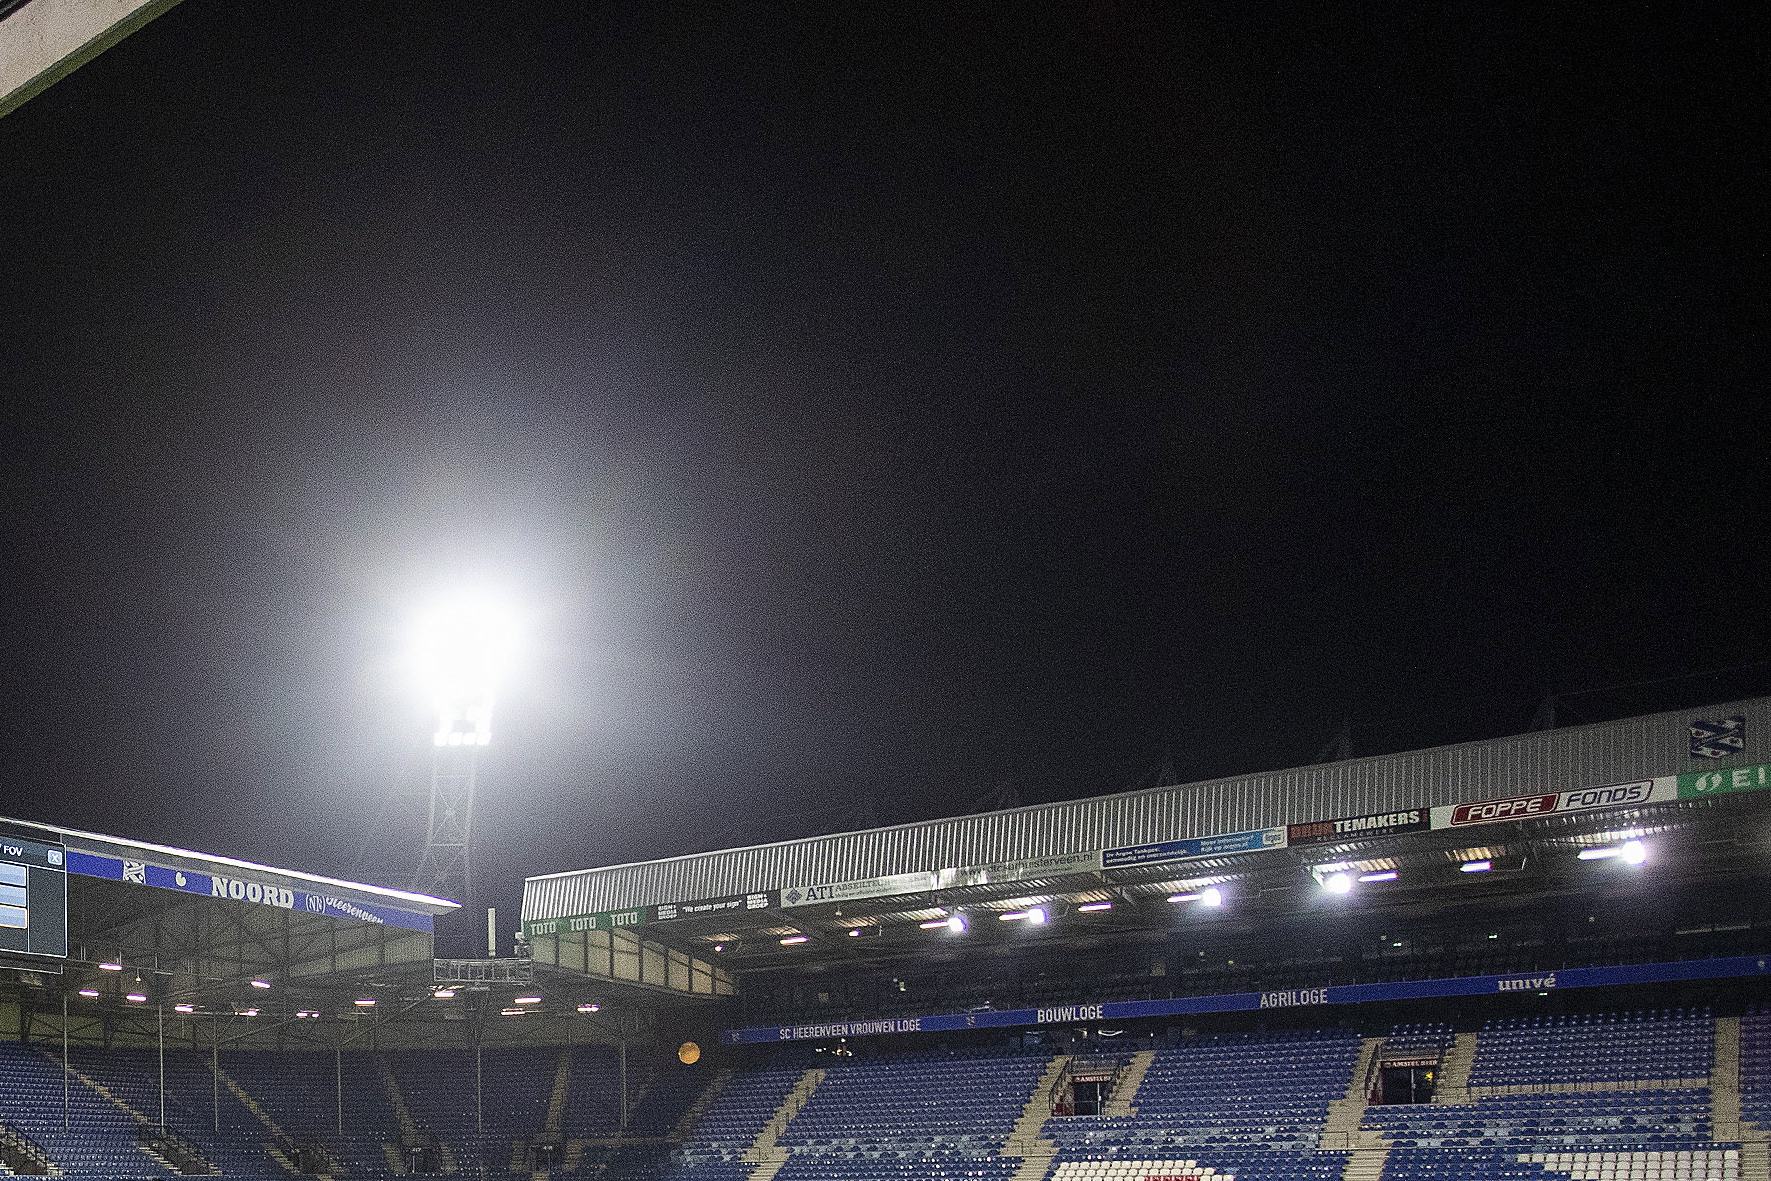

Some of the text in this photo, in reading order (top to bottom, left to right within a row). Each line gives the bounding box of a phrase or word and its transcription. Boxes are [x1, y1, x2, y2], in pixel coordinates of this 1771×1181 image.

[1467, 785, 1643, 821] FOPPE FONDS
[3, 845, 23, 857] FOV
[211, 876, 295, 909] NOORD
[806, 884, 835, 901] ATI
[711, 903, 726, 913] your
[569, 917, 597, 931] TOTO
[610, 911, 638, 927] TOTO
[530, 922, 556, 936] TOTO
[1498, 972, 1556, 992] univé
[1260, 986, 1328, 1009] AGRILOGE
[1037, 1005, 1104, 1024] BOUWLOGE
[779, 1018, 922, 1040] SC HEERENVEEN VROUWEN LOGE
